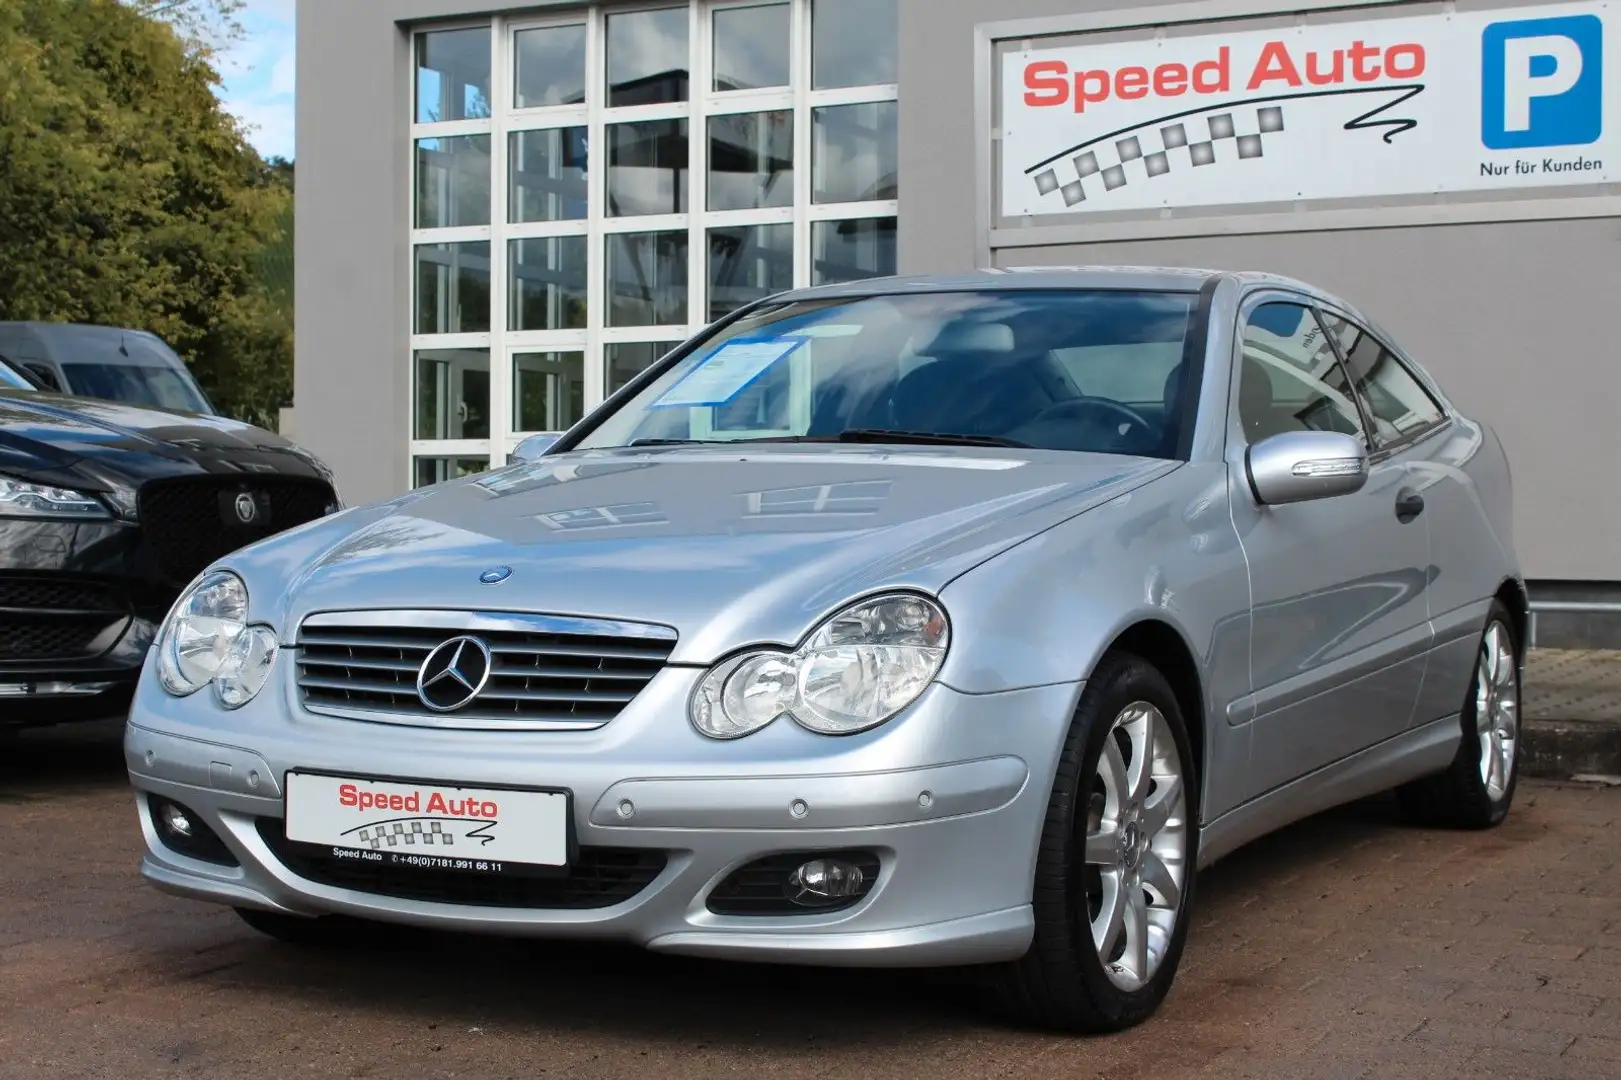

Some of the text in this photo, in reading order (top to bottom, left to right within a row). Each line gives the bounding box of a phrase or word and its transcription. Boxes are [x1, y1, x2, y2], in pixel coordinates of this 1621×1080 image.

[1024, 40, 1426, 113] Speed Auto
[1504, 34, 1583, 132] P
[1480, 156, 1603, 176] Nur für Kunden
[339, 784, 498, 818] Speed Auto
[333, 847, 502, 872] Speed Auto +49(0)7181.991 66 11
